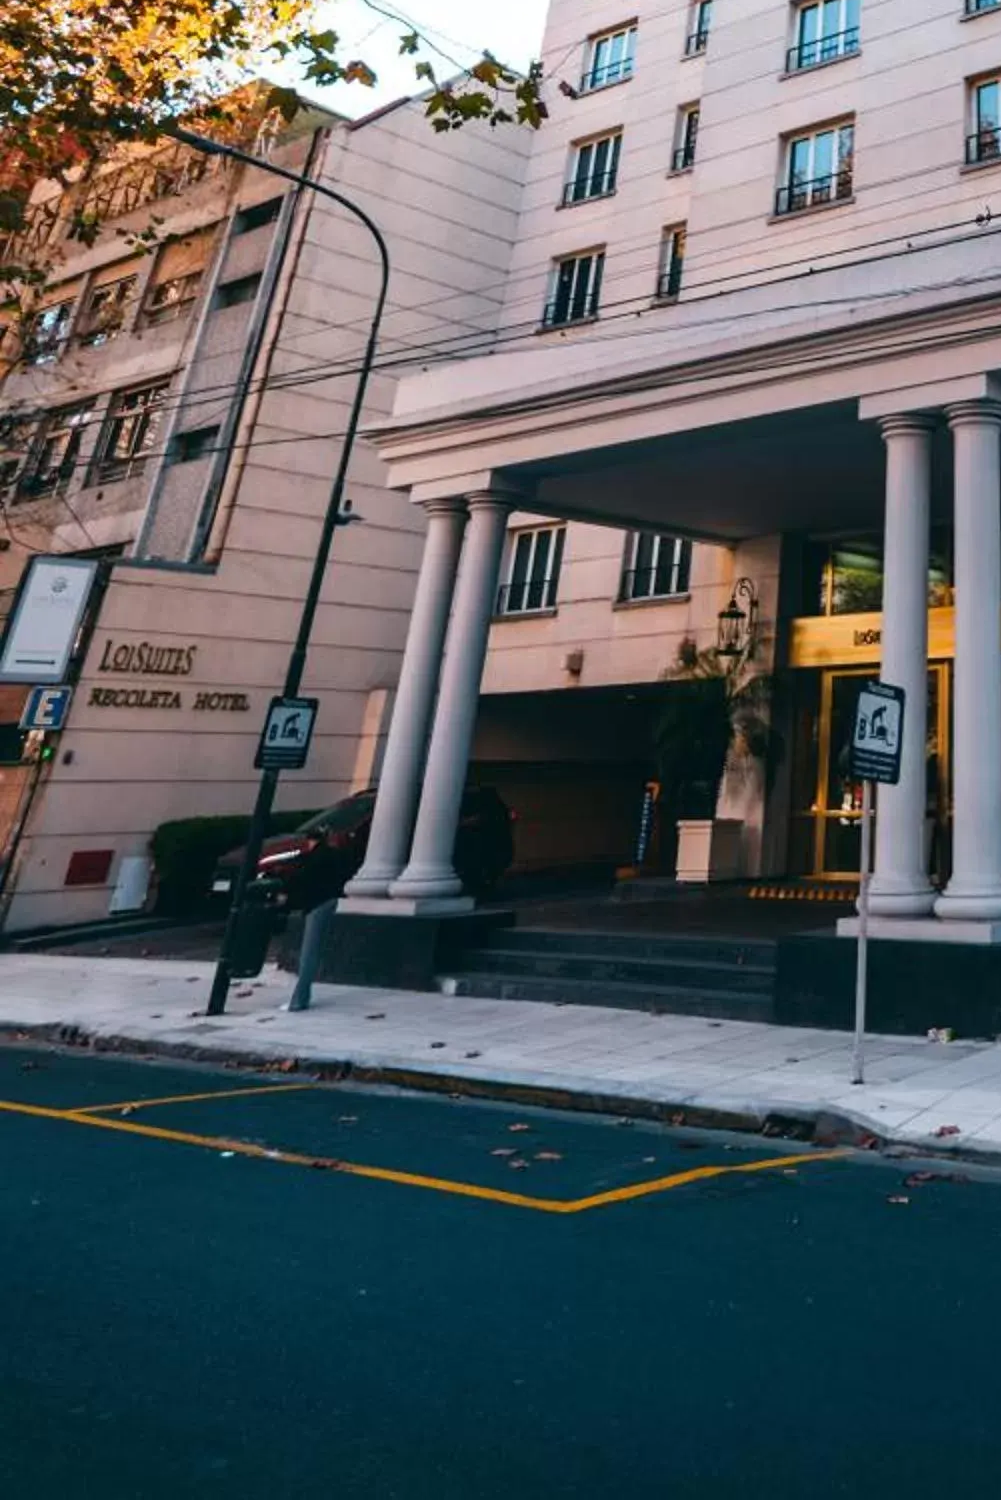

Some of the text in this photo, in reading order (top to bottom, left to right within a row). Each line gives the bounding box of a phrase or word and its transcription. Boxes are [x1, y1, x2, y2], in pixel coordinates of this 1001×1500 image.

[33, 690, 62, 725] E
[88, 687, 250, 711] RECOLETA HOTEL
